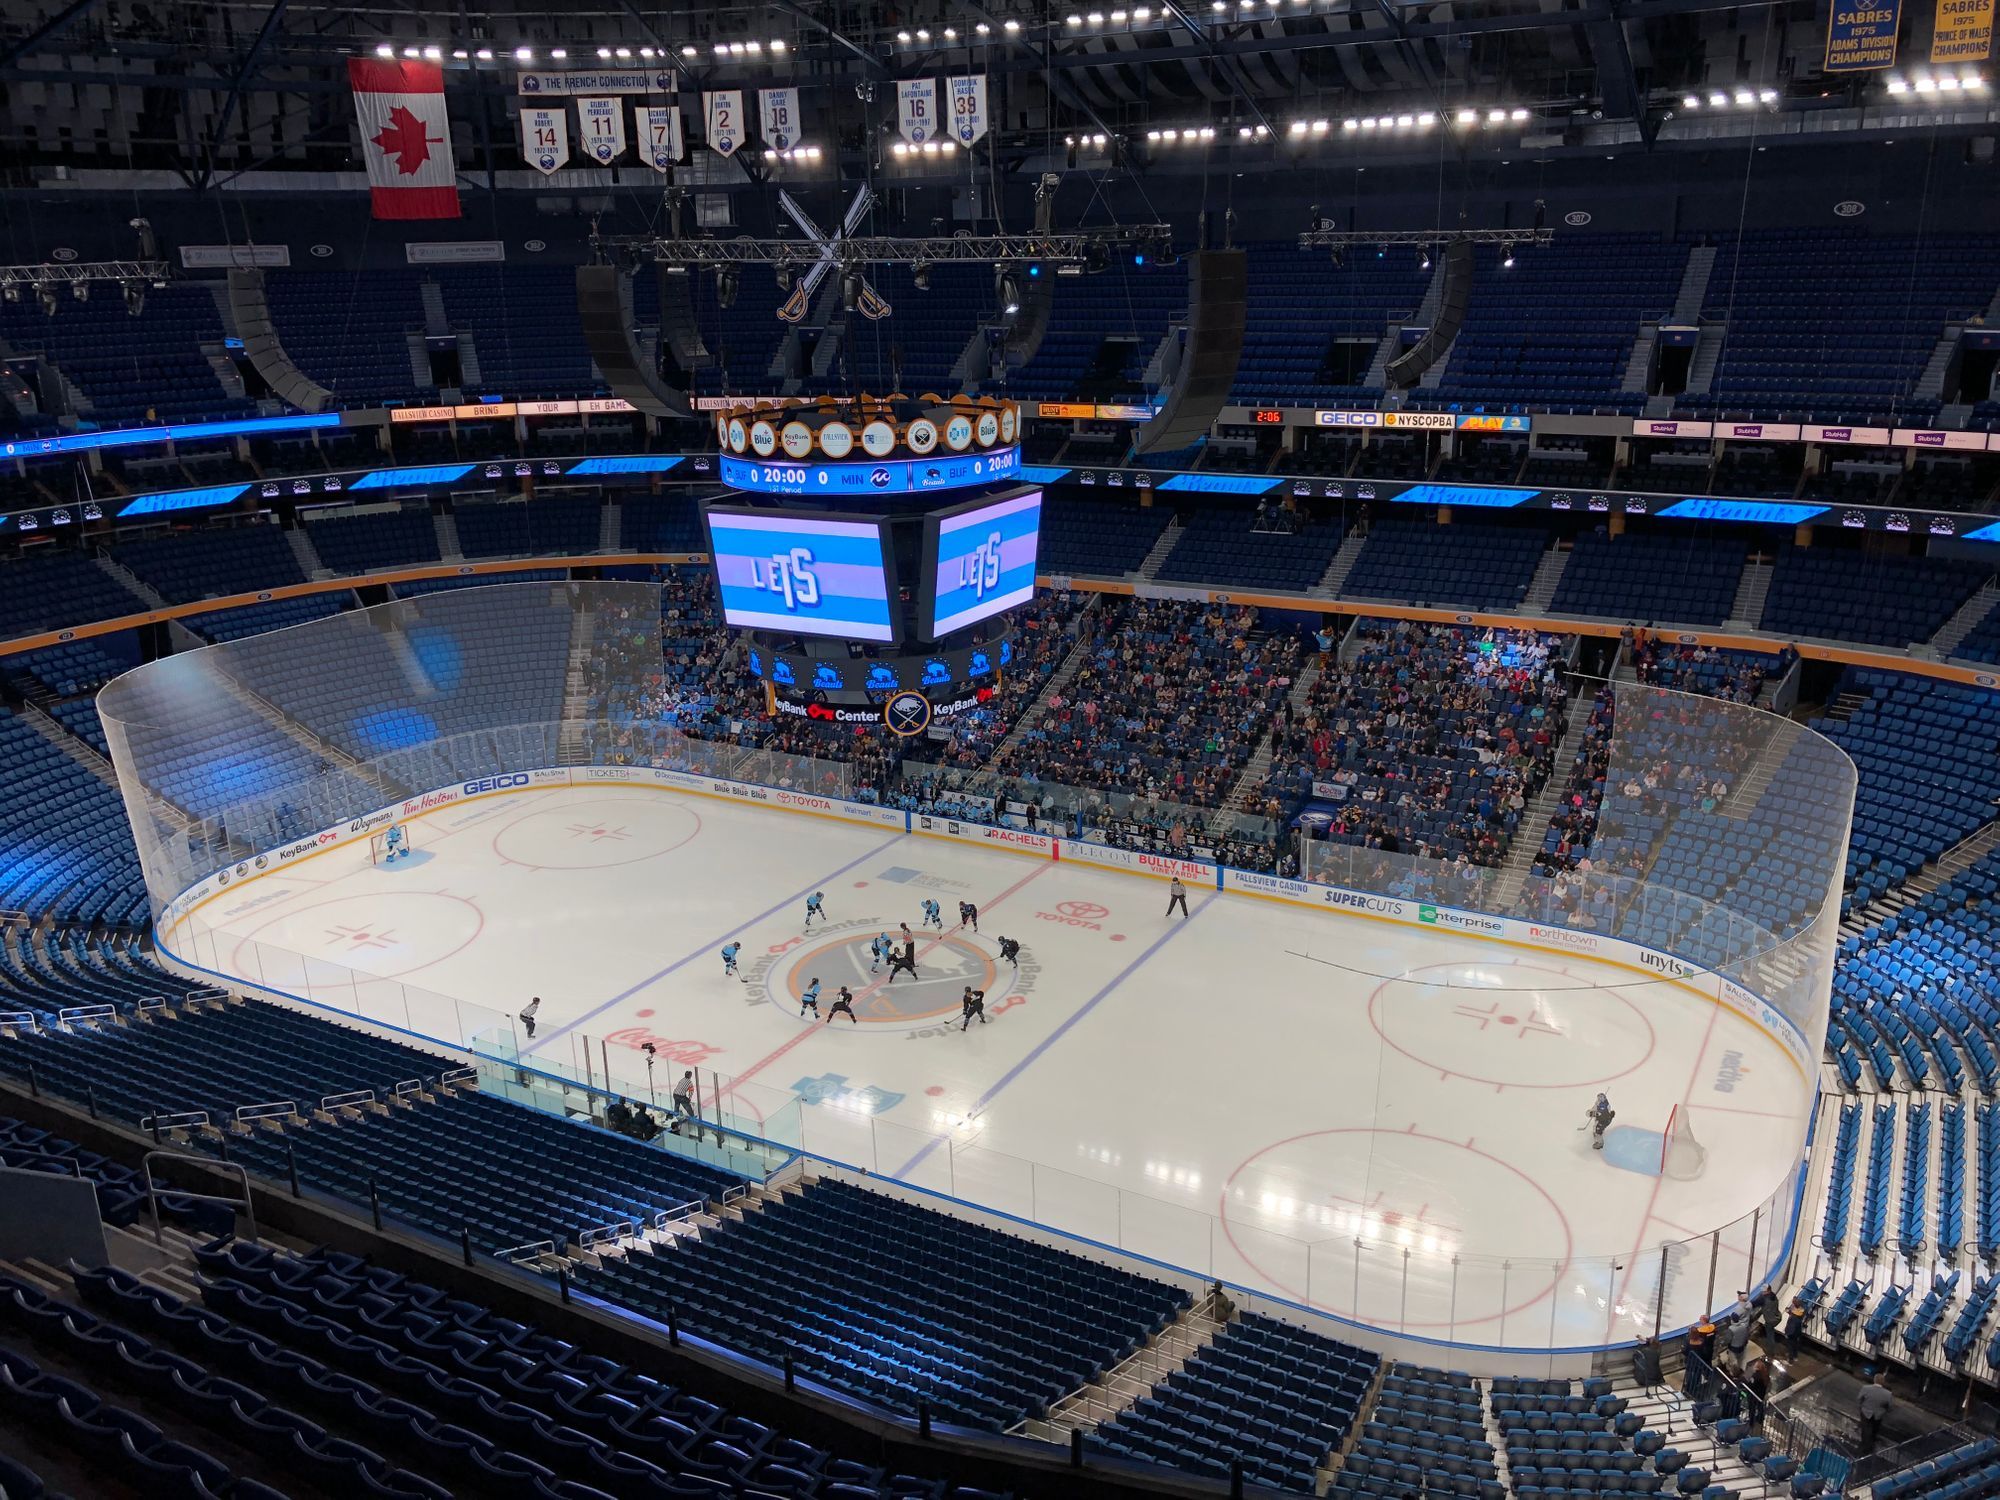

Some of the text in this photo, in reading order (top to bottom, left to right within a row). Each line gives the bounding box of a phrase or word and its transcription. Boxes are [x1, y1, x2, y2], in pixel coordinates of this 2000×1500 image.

[1942, 0, 1990, 15] SABRES
[1838, 10, 1892, 25] SABRES
[1953, 16, 1975, 25] 1975
[1852, 26, 1876, 36] 1975
[1935, 27, 1990, 42] PRINCE OF WALES
[1831, 36, 1894, 50] ADAMS DIVISION
[1934, 41, 1989, 57] CHAMPIONS
[1830, 50, 1892, 64] CHAMPIONS
[545, 75, 650, 88] THE FRENCH CONNECTION
[910, 99, 924, 118] 16
[592, 117, 612, 135] 11
[718, 110, 729, 128] 2
[534, 128, 556, 146] 14
[654, 127, 666, 144] 7
[474, 406, 498, 416] BRING
[537, 403, 559, 413] YOUR
[590, 400, 628, 411] EH GAME
[1257, 411, 1280, 422] 2:06
[1321, 413, 1377, 425] GEICO
[1398, 415, 1452, 427] NYSCOPBA
[1469, 416, 1505, 428] PLAY
[980, 426, 996, 436] Blue
[754, 435, 772, 445] Blue
[950, 467, 967, 478] BUF
[974, 461, 982, 475] 0
[989, 454, 1012, 472] 20:00
[751, 469, 758, 482] 0
[764, 468, 806, 483] 20:00
[818, 471, 828, 485] 0
[841, 475, 864, 485] MIN
[812, 679, 843, 689] Beauts
[865, 679, 898, 689] Beauts
[933, 696, 979, 716] KeyBank
[835, 709, 881, 722] Center
[464, 774, 529, 796] GEICO
[714, 784, 768, 800] Blue Blue Blue
[402, 791, 458, 816] Tim Hortons
[791, 795, 831, 810] TOYOTA
[843, 806, 872, 817] Walmart
[351, 812, 394, 833] Wegmans
[991, 830, 1047, 848] RACHEL'S
[280, 839, 318, 860] KeyBank
[1139, 855, 1210, 876] BULLY HILL
[1151, 866, 1198, 880] VINEYARDS
[1236, 873, 1308, 893] FALLSVIEW CASINO
[1325, 891, 1402, 914] SUPERCUTS
[801, 915, 882, 940] Center
[1034, 910, 1103, 931] TOYOTA
[1425, 909, 1502, 931] enterprise
[1530, 927, 1598, 947] northtown
[1640, 951, 1683, 976] unyts
